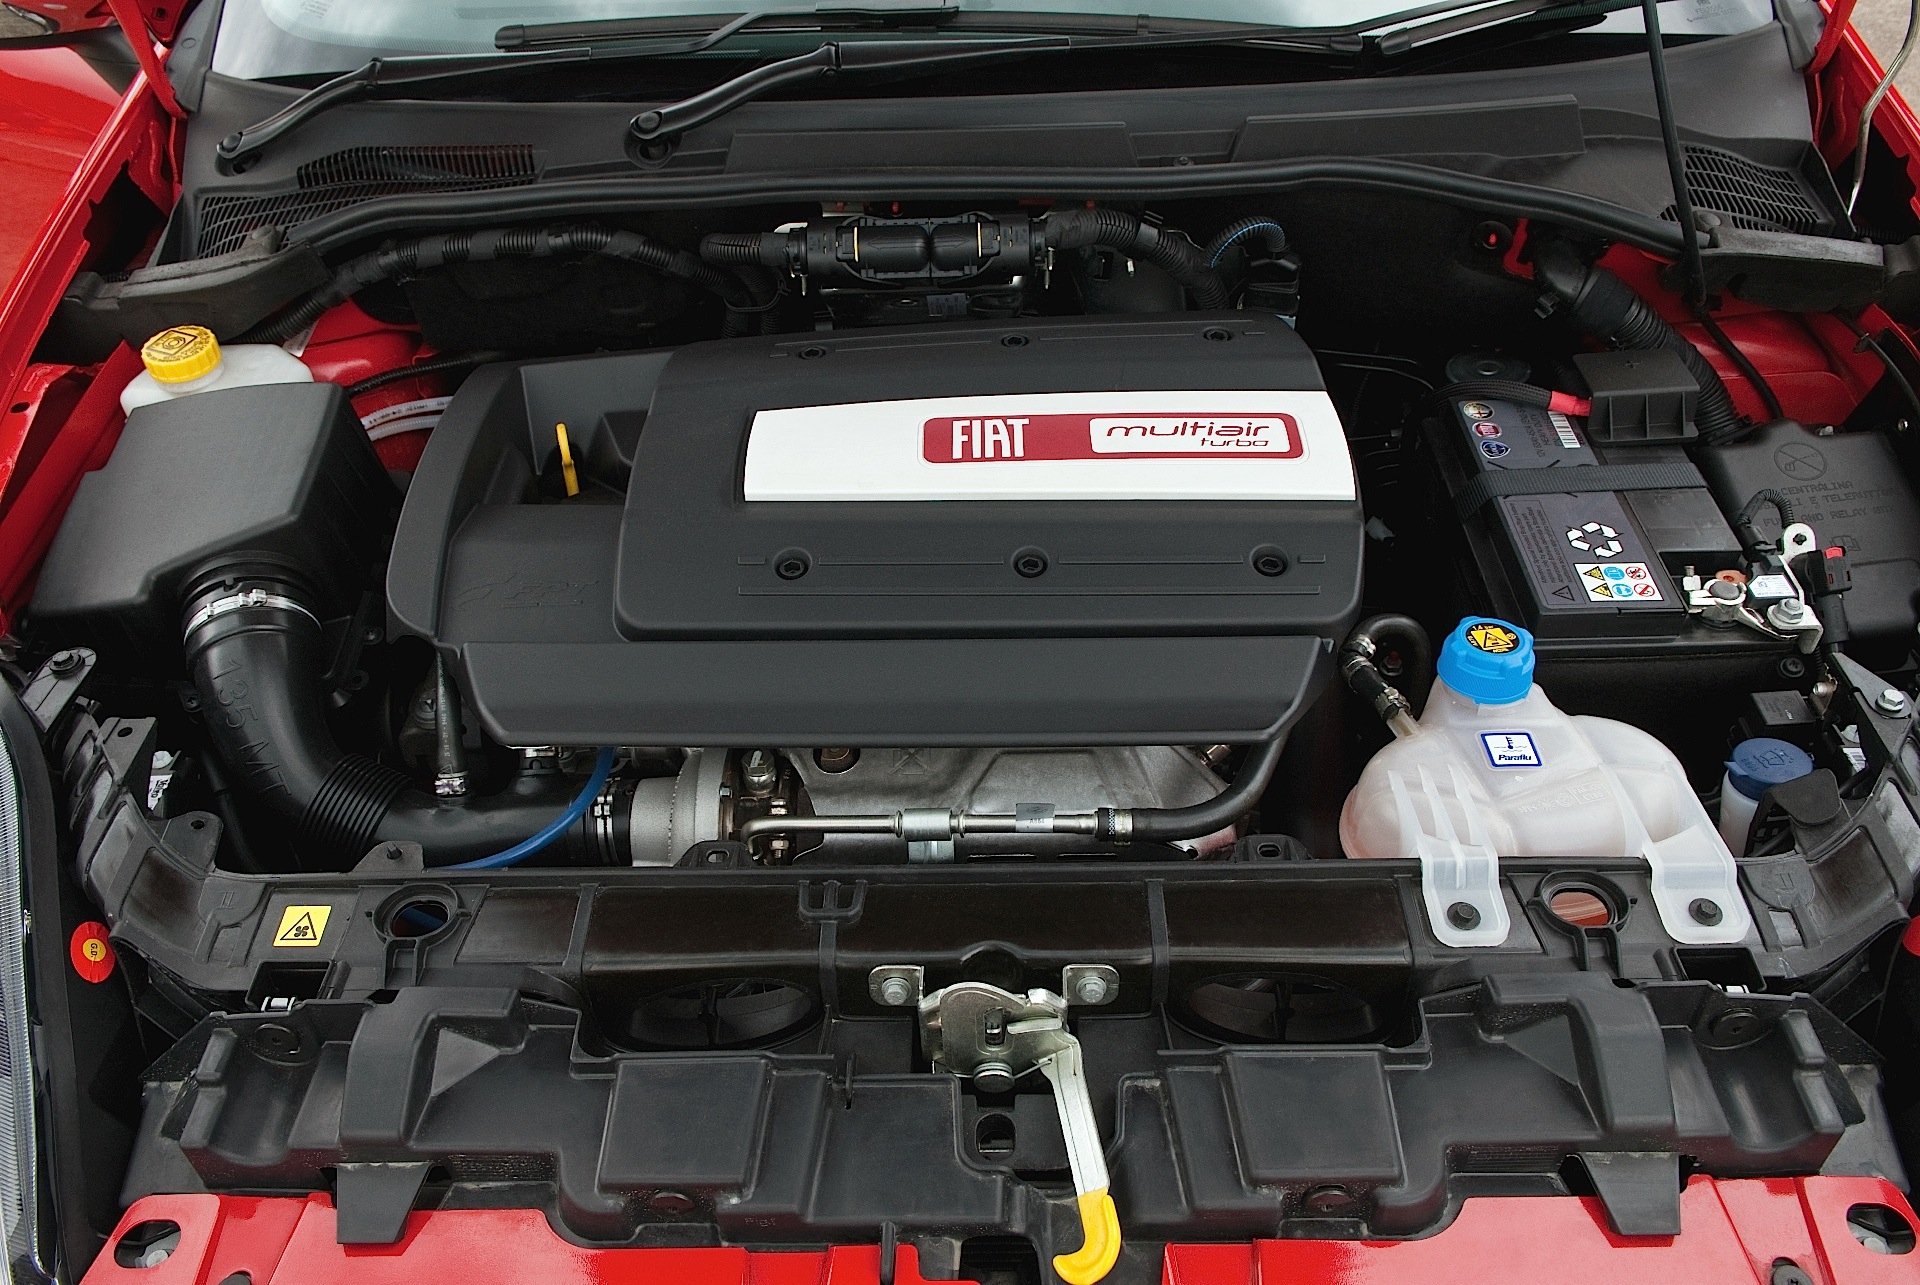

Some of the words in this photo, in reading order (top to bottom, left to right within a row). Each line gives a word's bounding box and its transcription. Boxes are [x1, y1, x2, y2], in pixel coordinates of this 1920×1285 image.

[952, 418, 1029, 459] FIAT
[1106, 420, 1270, 437] multiair
[1200, 437, 1269, 447] turbo
[1781, 481, 1854, 496] CENTRALINA
[1800, 512, 1824, 523] AND
[1831, 507, 1868, 520] RELAY
[212, 659, 259, 730] 135
[236, 737, 293, 796] MT
[1498, 753, 1532, 761] Paraflu
